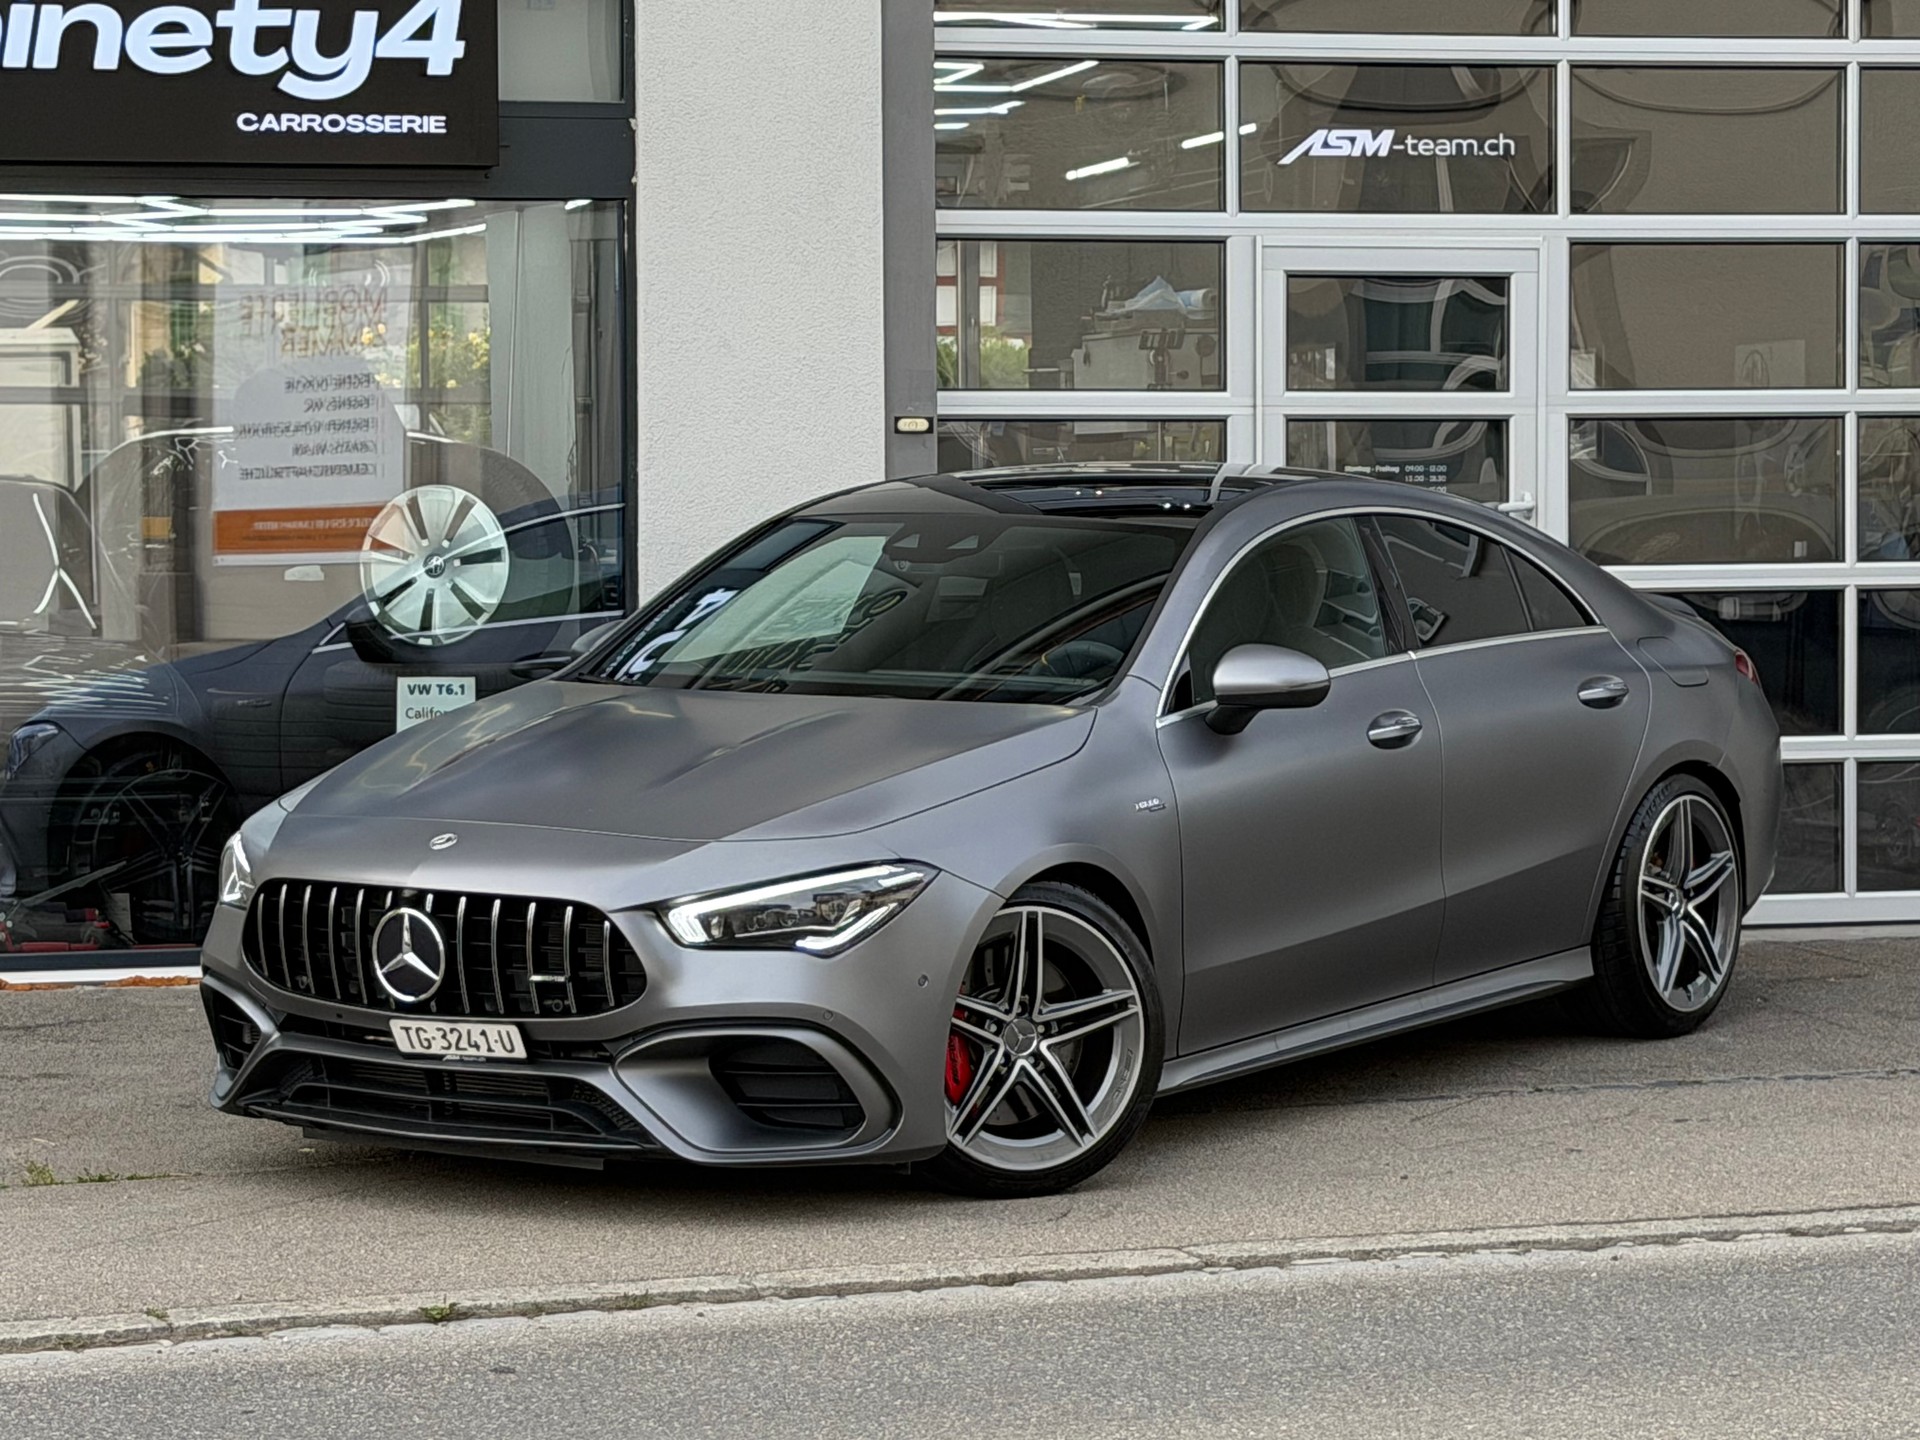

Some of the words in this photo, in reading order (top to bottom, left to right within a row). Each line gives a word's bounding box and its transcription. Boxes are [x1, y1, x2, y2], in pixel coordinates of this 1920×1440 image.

[0, 0, 466, 100] inety4
[236, 112, 447, 134] CARROSSERIE
[407, 684, 432, 695] VW
[436, 684, 465, 695] T6.1
[405, 707, 446, 720] Califo
